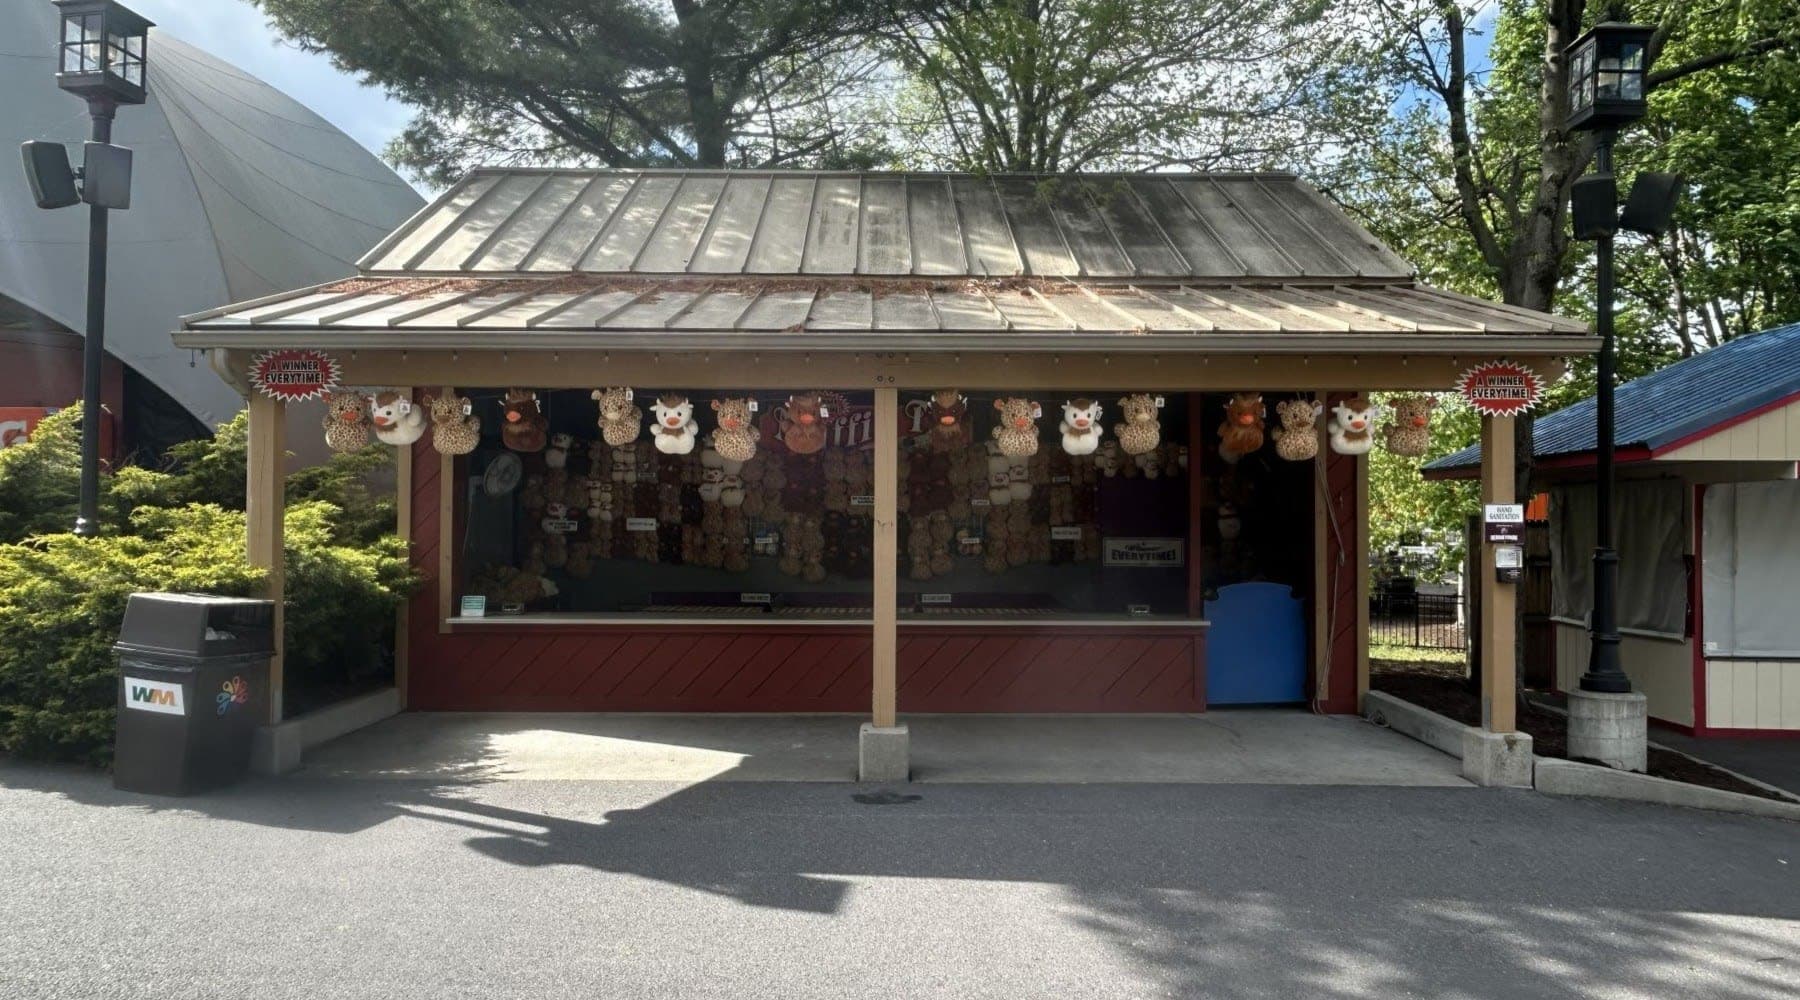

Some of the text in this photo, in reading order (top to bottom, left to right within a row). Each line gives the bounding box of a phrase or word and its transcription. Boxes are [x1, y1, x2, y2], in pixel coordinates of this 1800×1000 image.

[270, 360, 320, 371] A WINNER
[264, 372, 324, 384] EVERYTIME!
[1476, 376, 1525, 386] A WINNER
[1471, 388, 1531, 400] EVERYTIME!
[132, 686, 175, 706] WM
